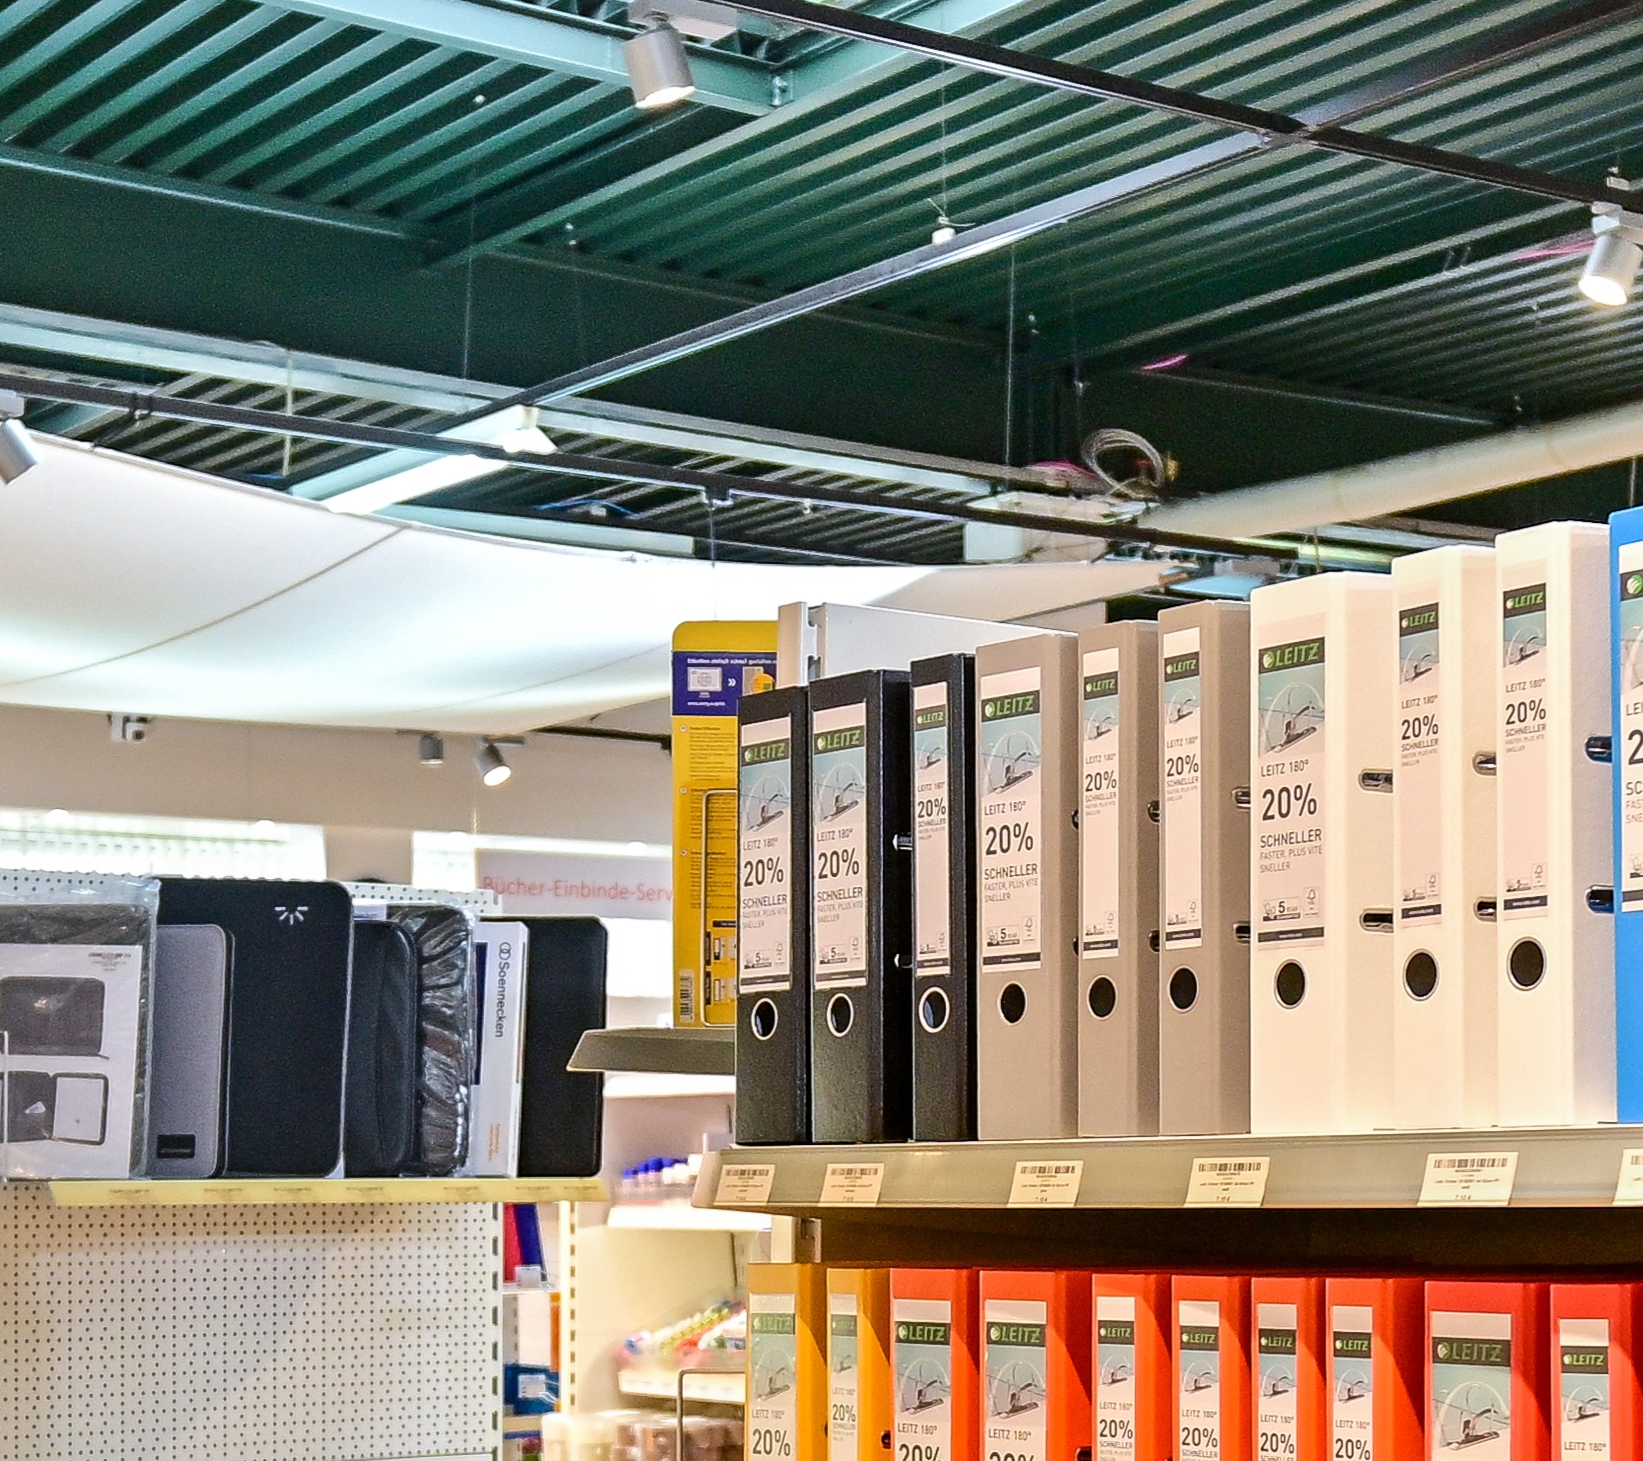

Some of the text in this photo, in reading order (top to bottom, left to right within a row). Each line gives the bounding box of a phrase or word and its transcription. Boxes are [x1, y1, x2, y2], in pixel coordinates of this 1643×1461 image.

[1515, 591, 1543, 608] LEITZ
[1410, 611, 1435, 627] LEITZ
[1276, 642, 1318, 666] LEITZ
[1173, 659, 1196, 673] LEITZ
[1093, 678, 1115, 692] LEITZ
[996, 695, 1034, 716] LEITZ
[1506, 698, 1546, 726] 20%
[923, 711, 943, 724] LEITZ
[1402, 714, 1438, 740] 20%
[827, 730, 859, 749] LEITZ
[754, 742, 785, 761] LEITZ
[1167, 754, 1199, 777] 20%
[1261, 760, 1284, 775] LEITZ
[1085, 770, 1116, 792] 20%
[918, 797, 946, 818] 20%
[1262, 781, 1317, 823] 20%
[986, 821, 1033, 857] 20%
[1260, 826, 1322, 848] SCHNELLER
[1289, 846, 1306, 858] PLUS
[744, 855, 783, 889] 20%
[818, 846, 859, 881] 20%
[984, 861, 1037, 880] SCHNELLER
[743, 891, 787, 910] SCHNELLER
[817, 885, 862, 902] SCHNELLER
[495, 962, 510, 1038] Soennecken
[909, 1326, 945, 1341] LEITZ
[1002, 1327, 1040, 1342] LEITZ
[1107, 1328, 1131, 1337] LEITZ
[1190, 1334, 1215, 1344] LEITZ
[1268, 1338, 1292, 1348] LEITZ
[1343, 1340, 1368, 1351] LEITZ
[1452, 1343, 1502, 1362] LEITZ
[1573, 1355, 1604, 1366] LEITZ
[832, 1404, 855, 1422] 20%
[1100, 1419, 1133, 1439] 20%
[1182, 1427, 1218, 1448] 20%
[752, 1429, 790, 1456] 20%
[1260, 1433, 1294, 1454] 20%
[1335, 1438, 1370, 1461] 20%
